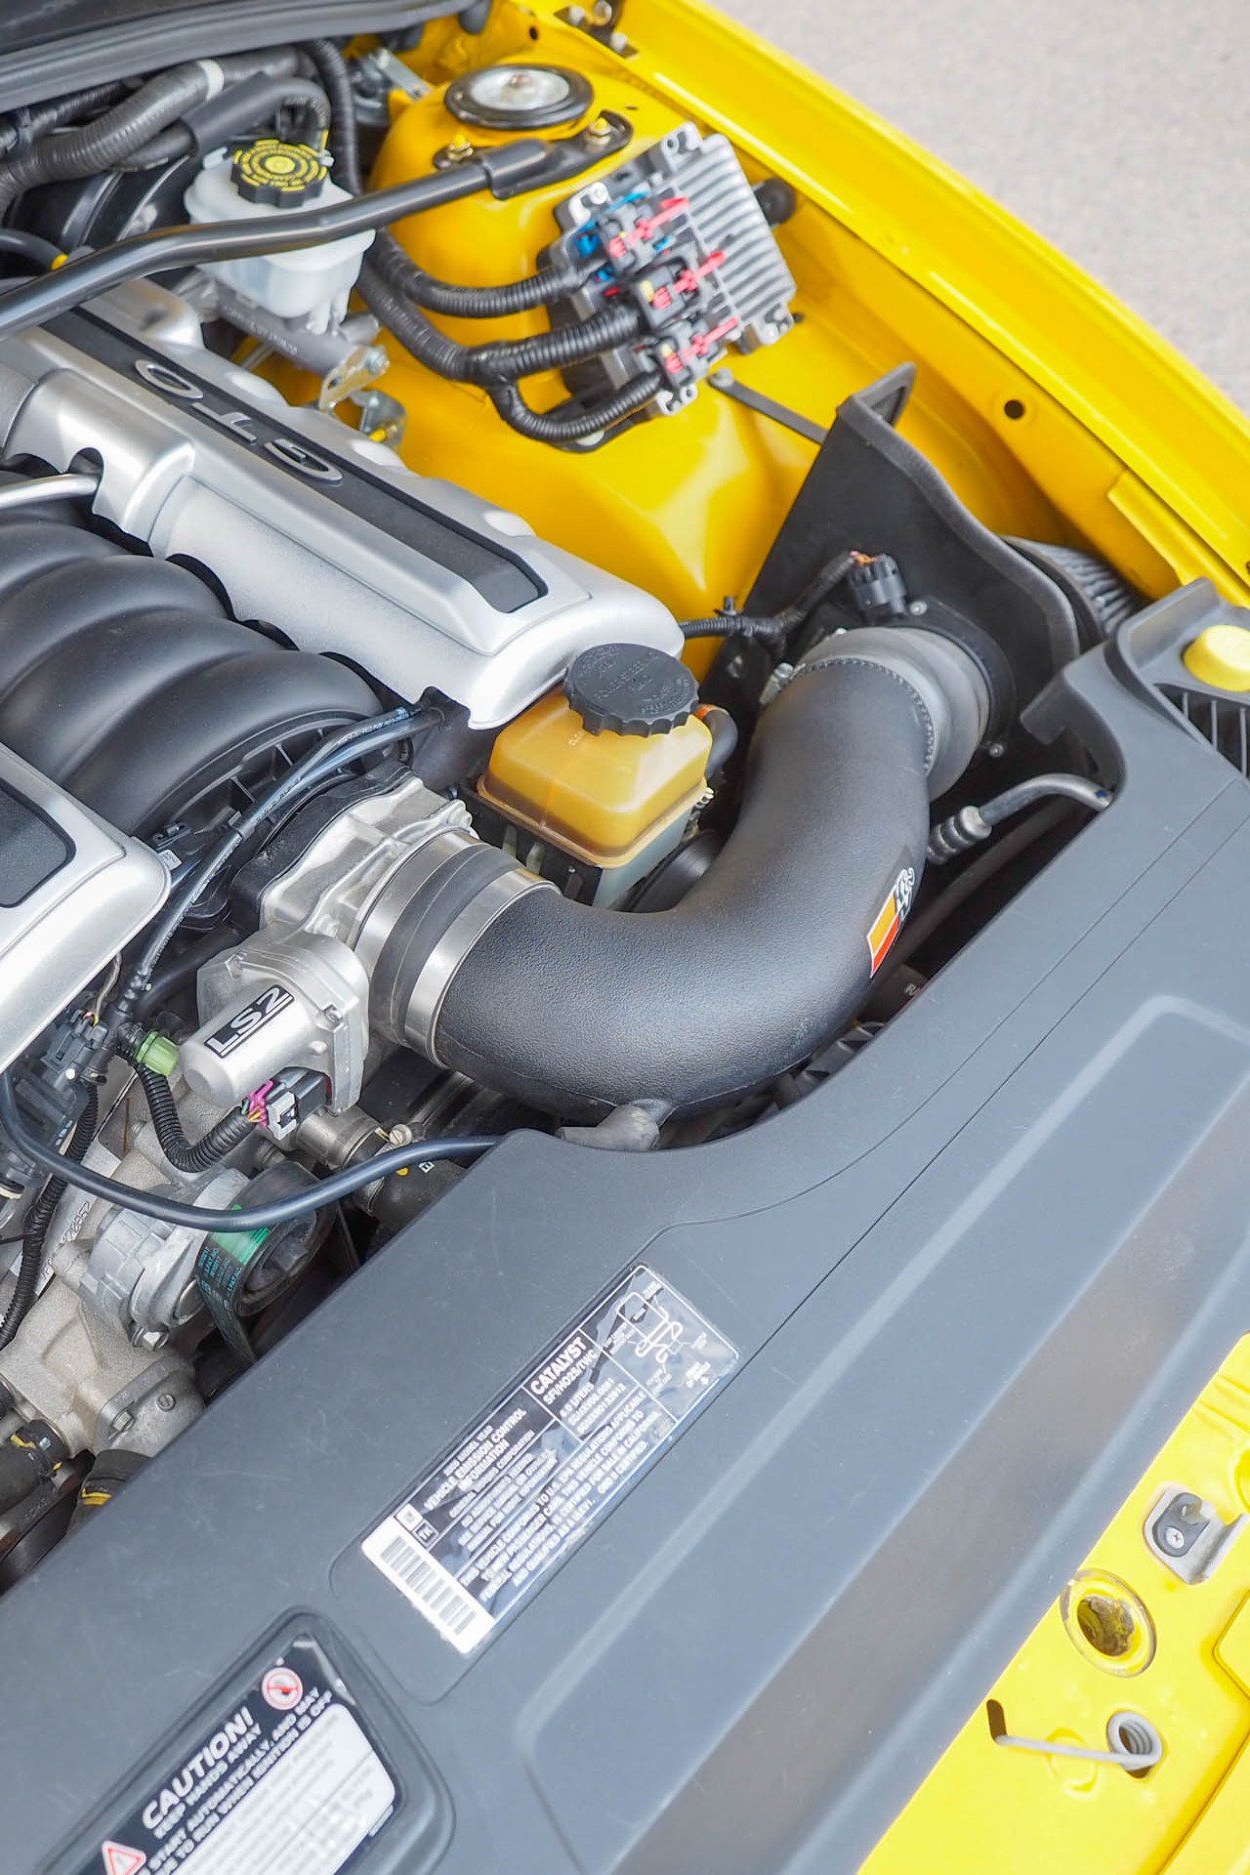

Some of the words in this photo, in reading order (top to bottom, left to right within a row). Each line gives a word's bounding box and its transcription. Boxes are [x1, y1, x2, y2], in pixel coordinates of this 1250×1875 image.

[134, 359, 342, 482] GTO
[208, 988, 291, 1053] LS2
[528, 1335, 589, 1396] CATALYST
[423, 1474, 460, 1511] VEHICLE
[453, 1438, 495, 1480] EMISSION
[488, 1405, 527, 1444] CONTROL
[456, 1437, 510, 1492] INFORMATION
[535, 1491, 550, 1506] TO
[269, 1711, 299, 1742] AND
[307, 1689, 336, 1718] OFF
[141, 1707, 257, 1830] CAUTION!
[183, 1759, 230, 1807] HANDS
[224, 1722, 265, 1764] AWAY
